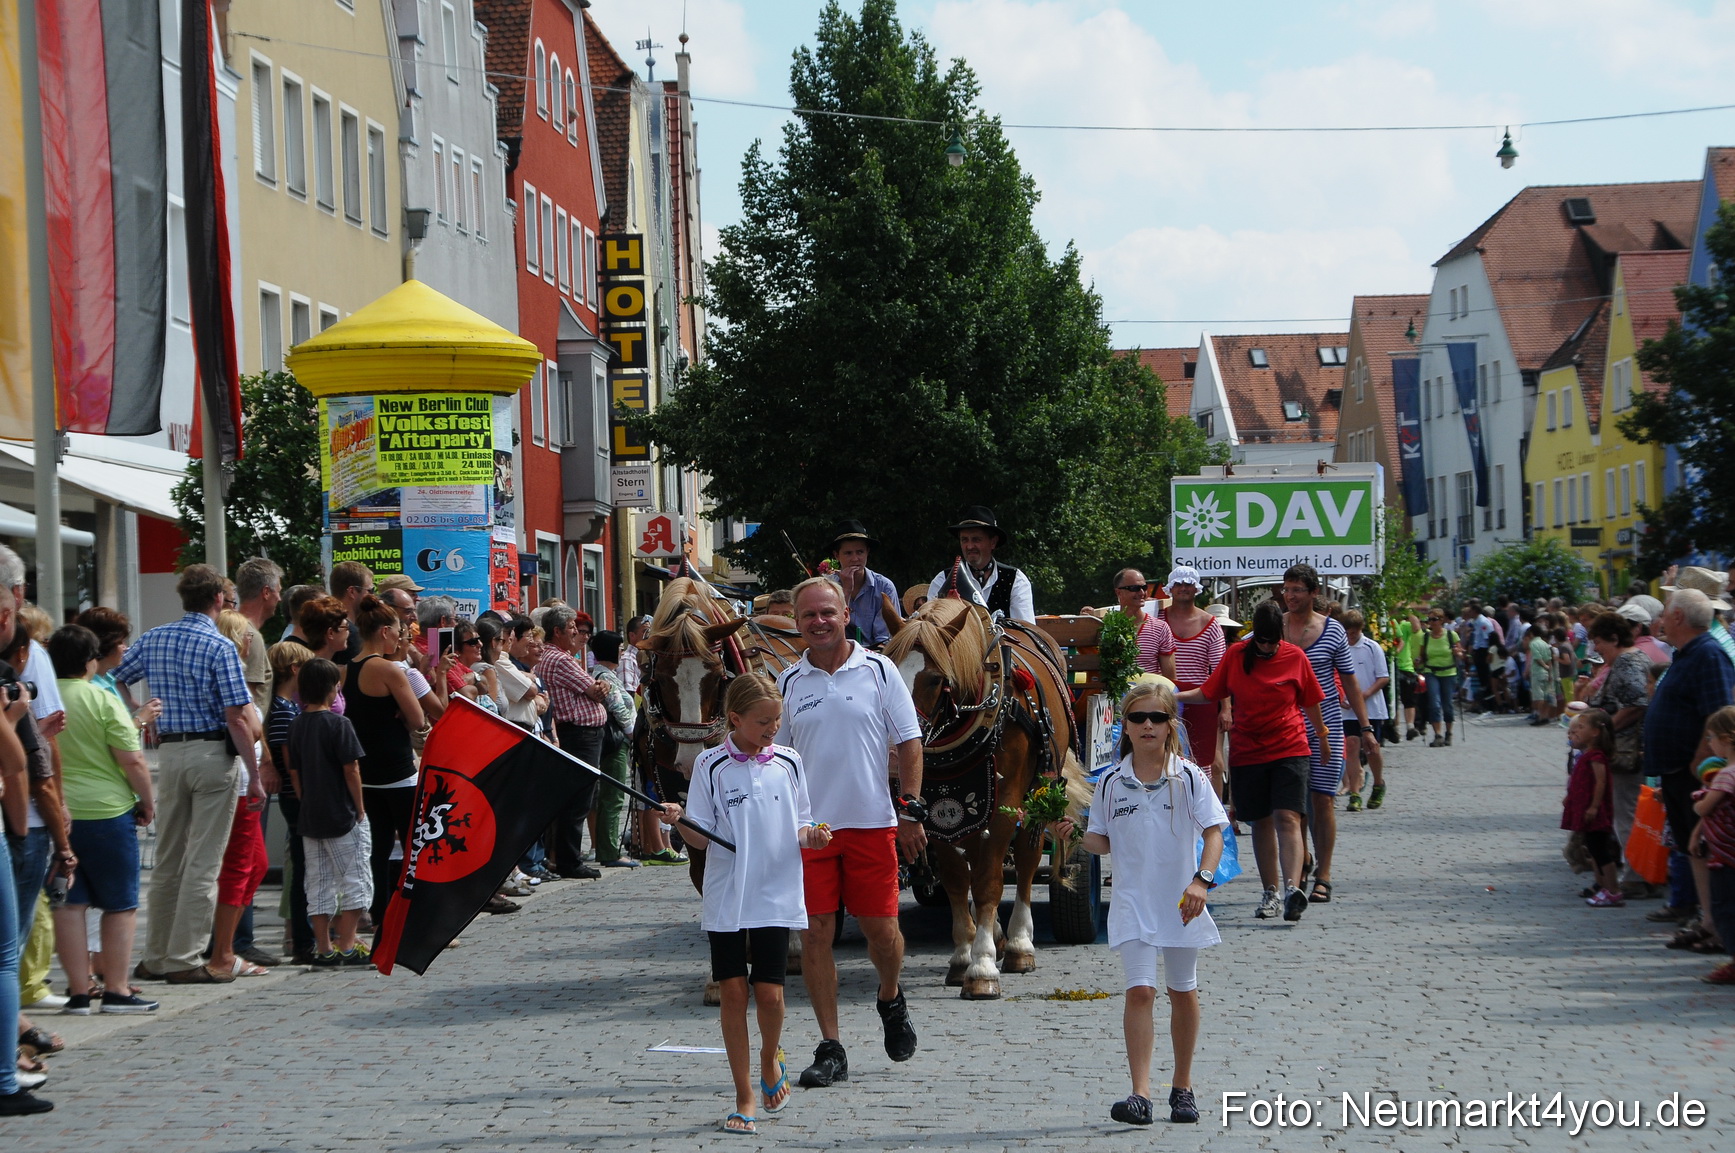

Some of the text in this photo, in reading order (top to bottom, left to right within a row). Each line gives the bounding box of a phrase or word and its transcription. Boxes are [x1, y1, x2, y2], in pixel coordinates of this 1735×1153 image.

[606, 239, 646, 455] HOTEL
[379, 397, 489, 413] New Berlin Club
[380, 414, 490, 432] Volksfest
[380, 453, 387, 462] FR
[409, 452, 417, 460] SA
[461, 451, 492, 459] Einlass
[395, 462, 401, 471] FR
[422, 461, 430, 469] SA
[461, 460, 475, 468] 24
[476, 459, 492, 468] UHR
[612, 468, 649, 476] Altstadthotel
[617, 478, 645, 487] Stern
[406, 516, 437, 524] 02.08
[440, 515, 455, 524] bis
[1236, 490, 1365, 539] DAV
[343, 534, 381, 545] 35 Jahre
[332, 547, 402, 562] Jacobikirwa
[416, 547, 465, 573] G6
[375, 561, 402, 571] Heng
[1175, 554, 1373, 571] Sektion Neumarkt i.d. OPf.
[454, 600, 477, 615] Party
